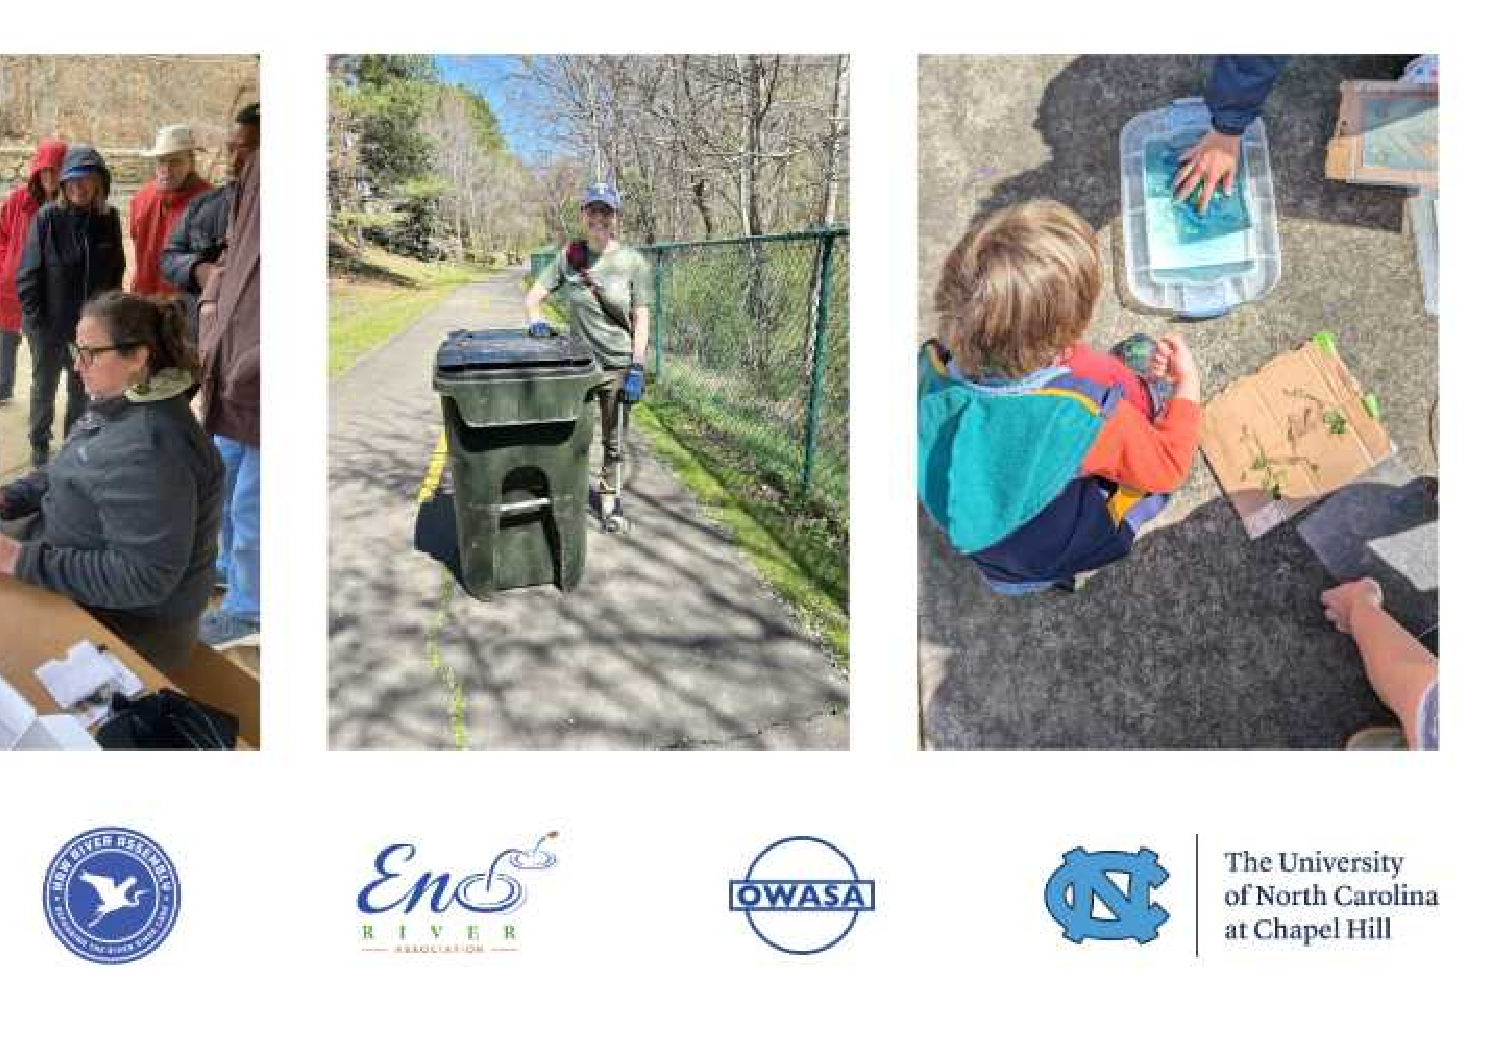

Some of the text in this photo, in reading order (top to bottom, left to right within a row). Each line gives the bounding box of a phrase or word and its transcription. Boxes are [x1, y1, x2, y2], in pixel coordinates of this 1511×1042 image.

[70, 835, 113, 860] RIVER
[117, 836, 173, 891] ASSEMBLY
[1224, 851, 1404, 879] The University
[356, 843, 526, 914] Eno
[737, 884, 866, 907] OWASA
[1224, 884, 1439, 907] of North Carolina
[362, 925, 516, 940] RIVER
[1224, 917, 1391, 946] at Chapel Hill
